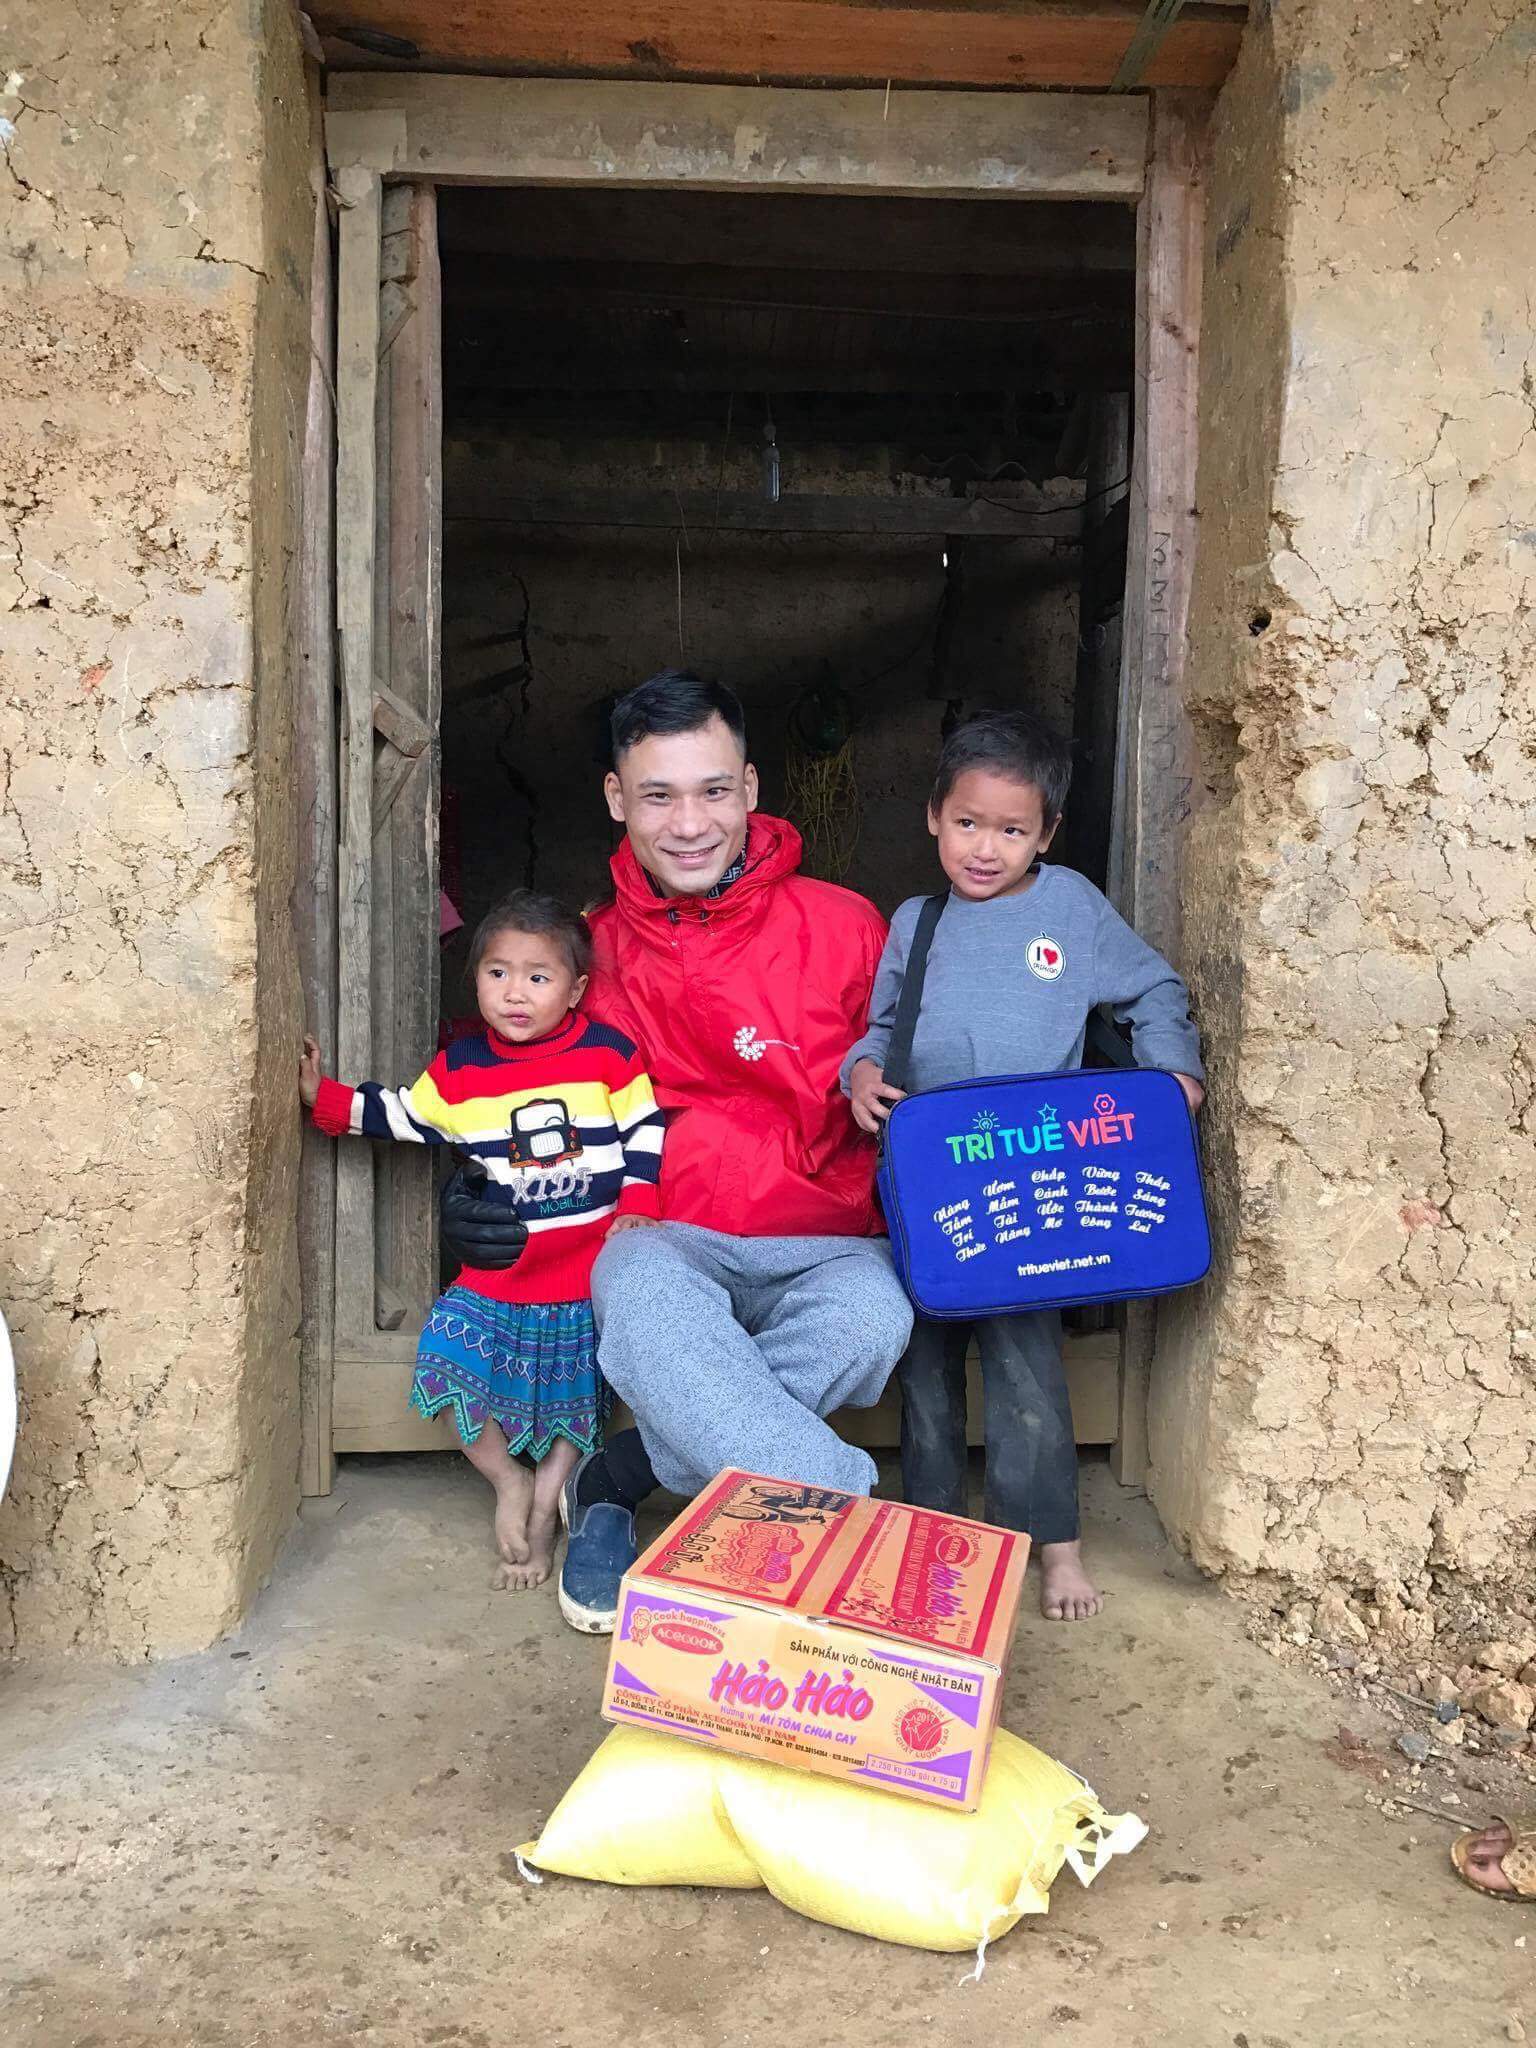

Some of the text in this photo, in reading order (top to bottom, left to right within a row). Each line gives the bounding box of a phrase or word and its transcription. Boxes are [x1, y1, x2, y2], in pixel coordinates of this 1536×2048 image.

[1082, 1167, 1120, 1181] Vững
[1034, 1185, 1069, 1200] Cánh
[1084, 1183, 1117, 1196] Bước
[986, 1196, 1019, 1215] Mầm
[1075, 1200, 1118, 1213] Thành
[1133, 1189, 1167, 1208] Sáng
[1037, 1200, 1065, 1215] Ước
[1125, 1204, 1165, 1224] Tương
[994, 1212, 1018, 1228] Tài
[1041, 1217, 1063, 1230] Mơ
[1080, 1216, 1112, 1229] Công
[1128, 1220, 1152, 1233] Lai
[995, 1226, 1031, 1243] Năng
[1017, 1254, 1111, 1276] tritueviet.net.vn
[681, 1533, 717, 1553] 9,6
[653, 1611, 726, 1638] Cook happiness
[790, 1640, 972, 1693] SẢN PHẨM VỚI CÔNG NGHỆ NHẬT BẢN
[709, 1659, 874, 1721] Hảo Hảo
[616, 1688, 796, 1742] CÔNG TY CỔ PHẦN ACECOOK VIỆT NAM
[648, 1704, 655, 1712] SỐ
[721, 1705, 744, 1719] Hương
[778, 1716, 801, 1732] TÔM
[804, 1724, 833, 1740] CHUA
[835, 1732, 858, 1746] CAY
[894, 1763, 902, 1775] kg
[904, 1765, 917, 1777] (30
